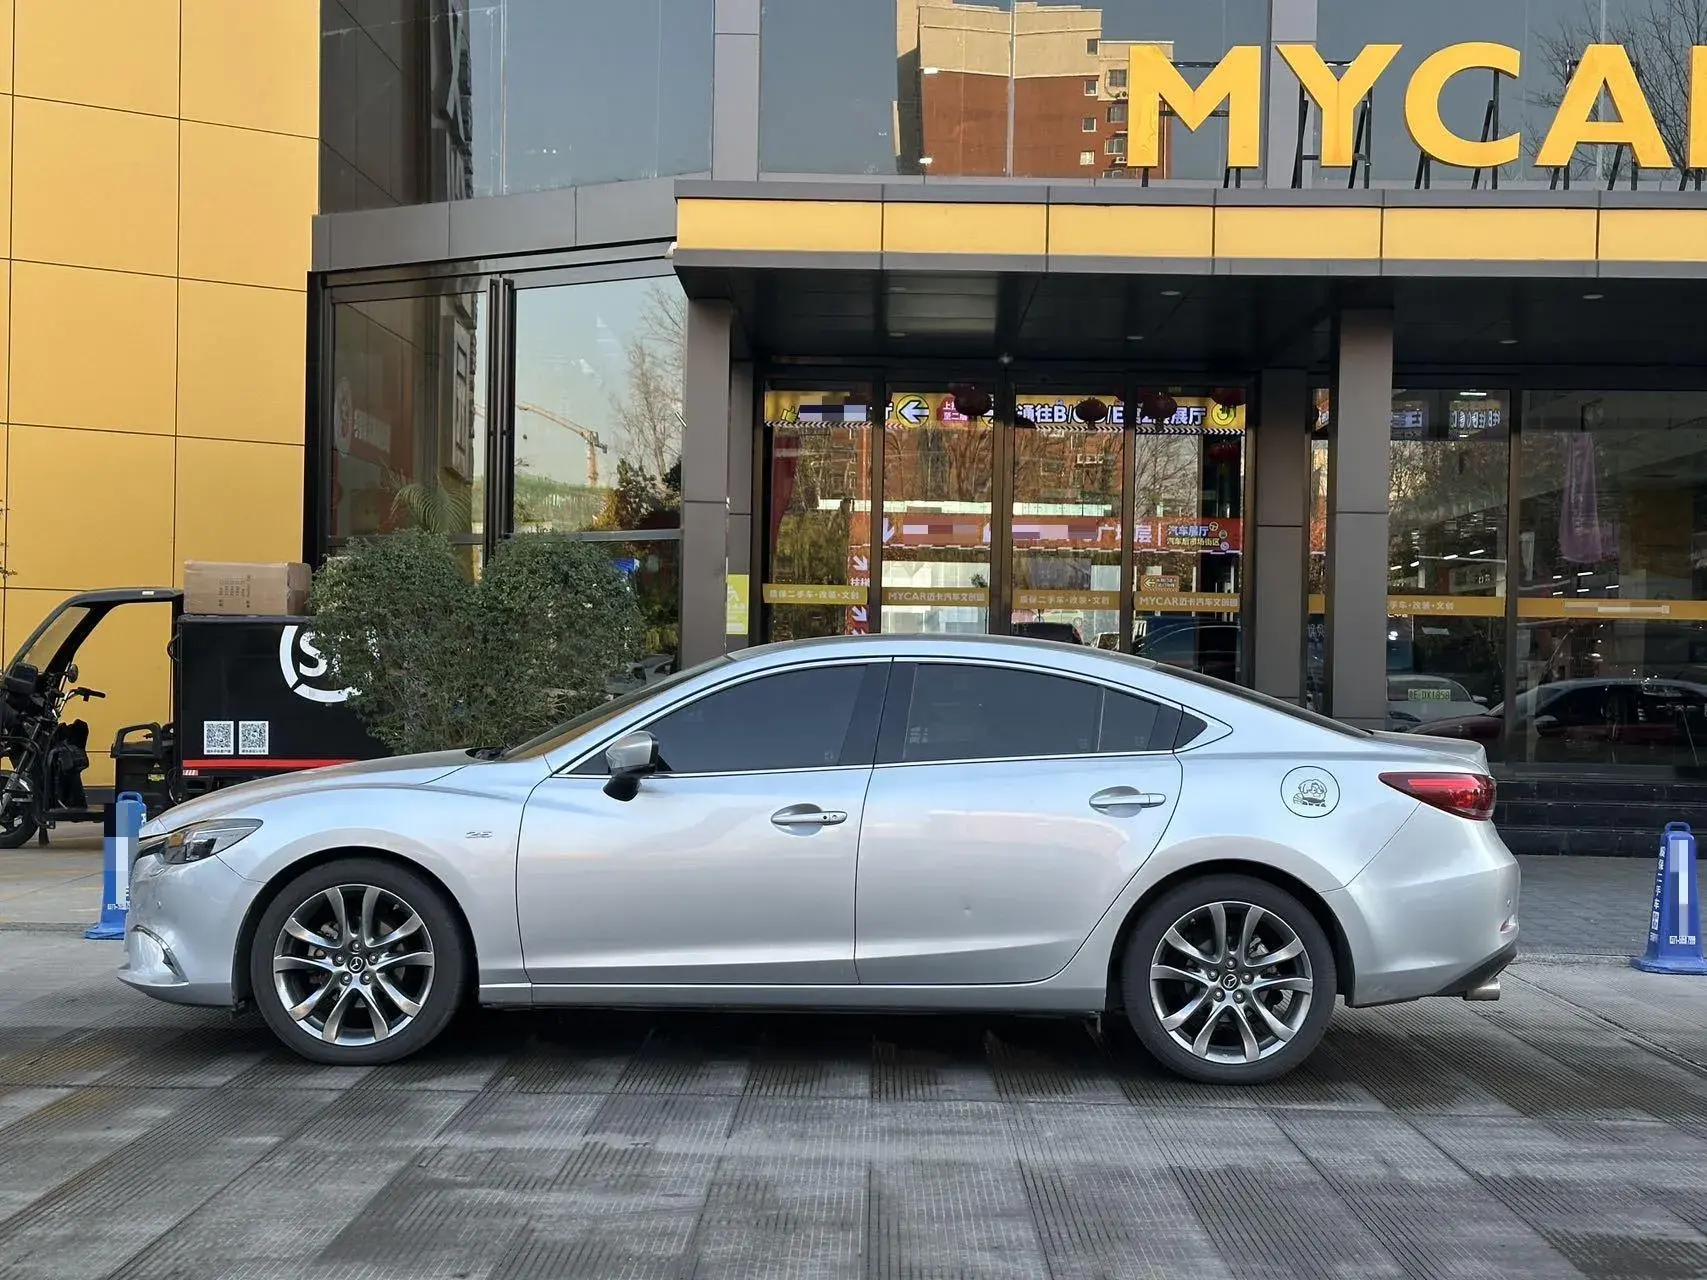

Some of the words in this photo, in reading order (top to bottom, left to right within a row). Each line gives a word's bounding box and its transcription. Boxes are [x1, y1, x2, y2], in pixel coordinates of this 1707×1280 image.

[1127, 41, 1707, 168] MYCA
[1167, 525, 1209, 537] 汽车展厅
